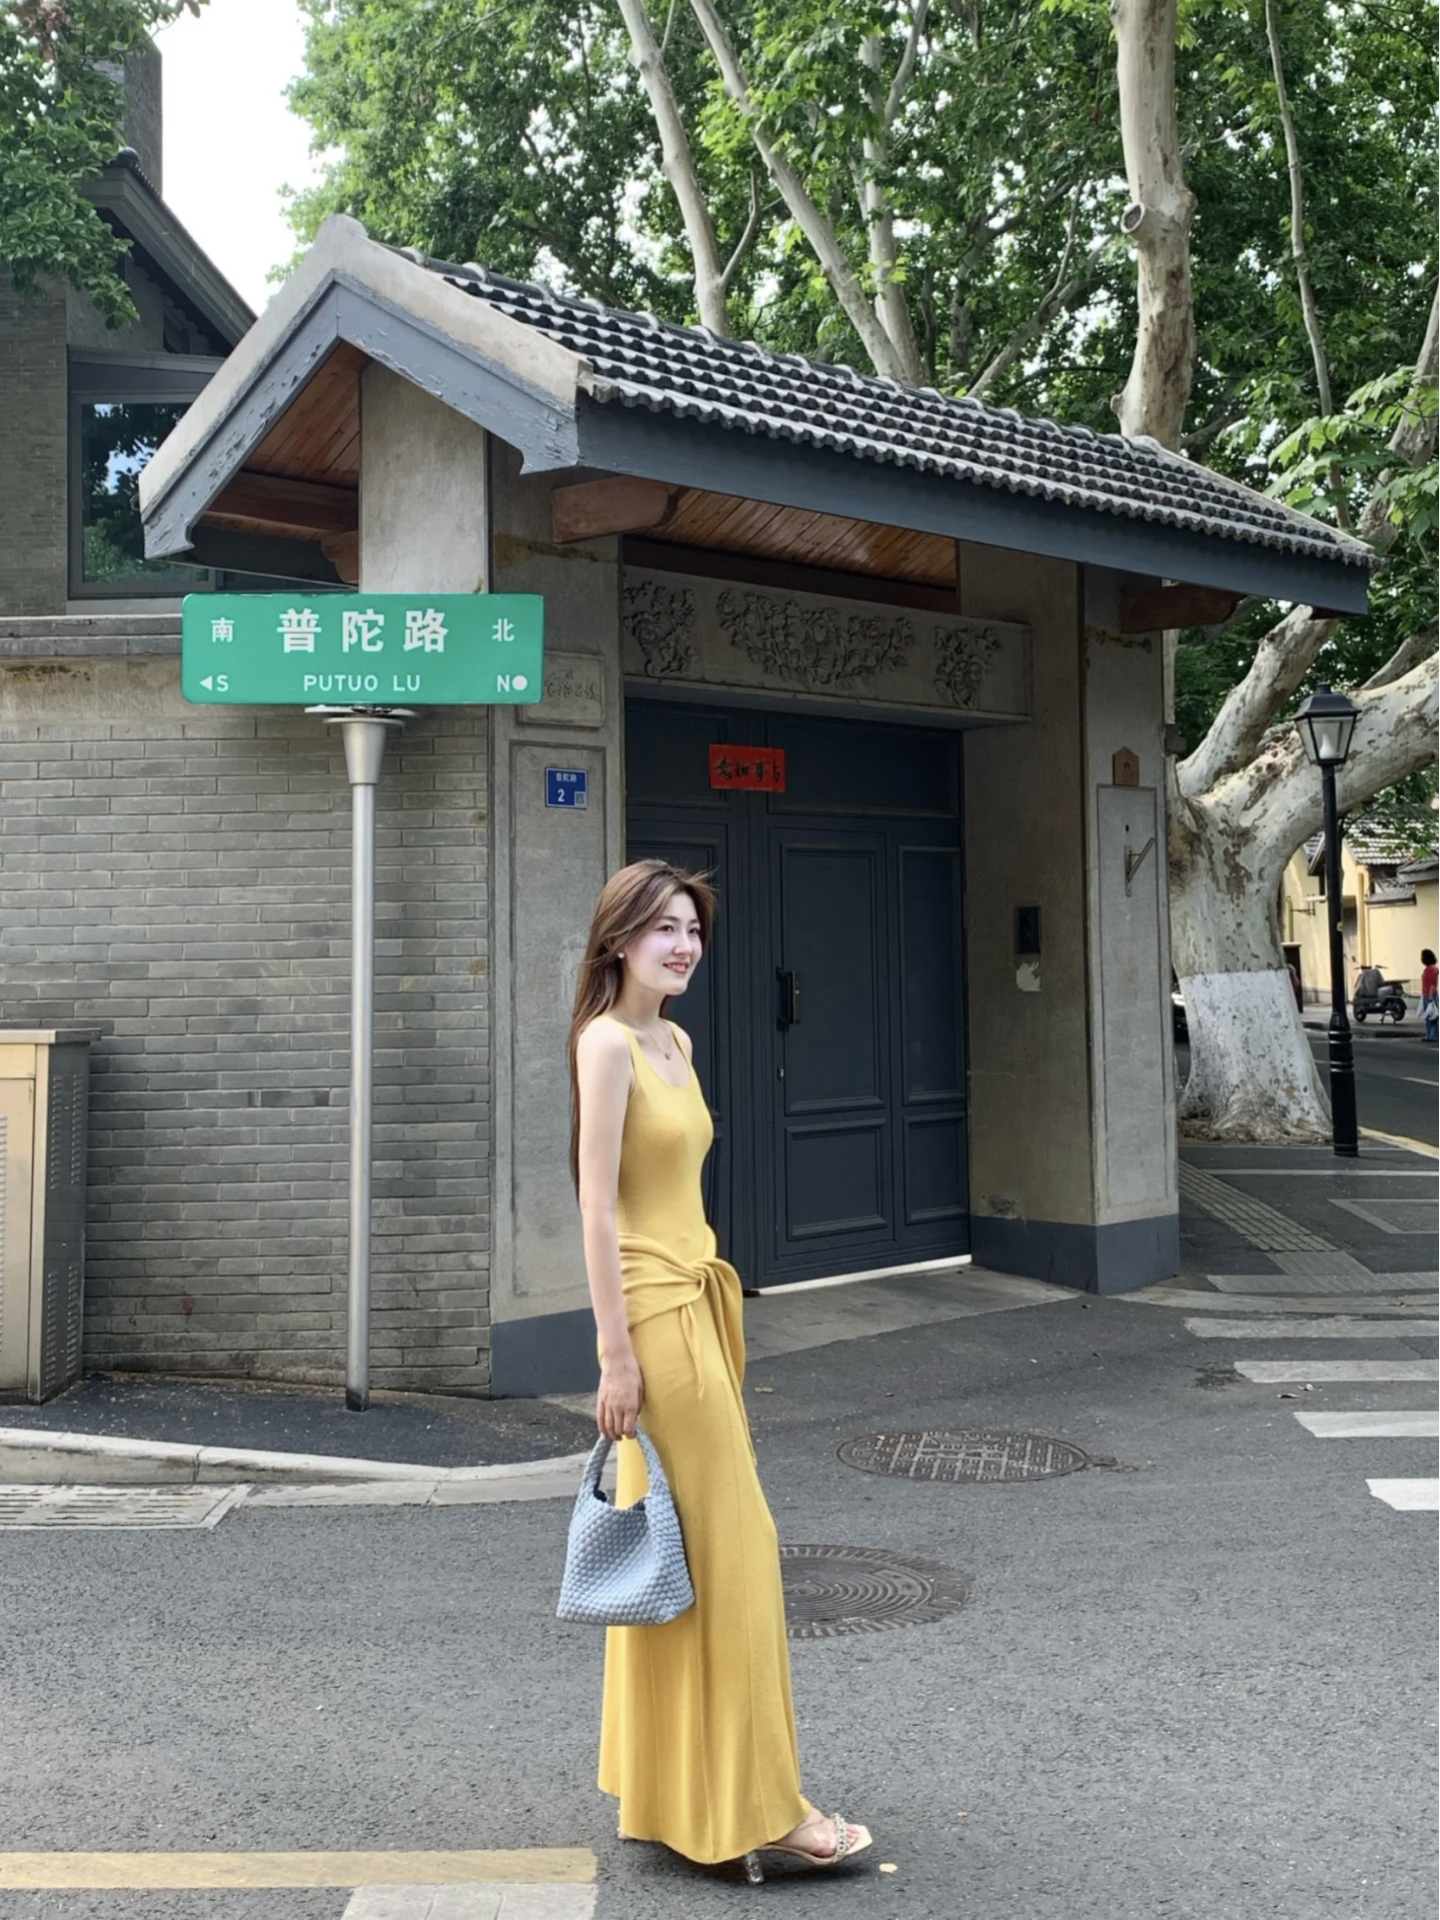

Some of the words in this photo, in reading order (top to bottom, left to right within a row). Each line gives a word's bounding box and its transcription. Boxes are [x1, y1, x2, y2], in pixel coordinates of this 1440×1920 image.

[210, 617, 234, 642] 南
[277, 608, 449, 653] 普陀路
[492, 618, 515, 642] 北
[217, 675, 229, 692] S
[304, 675, 378, 692] PUTUO
[393, 675, 420, 692] LU
[497, 675, 510, 692] N
[557, 788, 566, 802] 2
